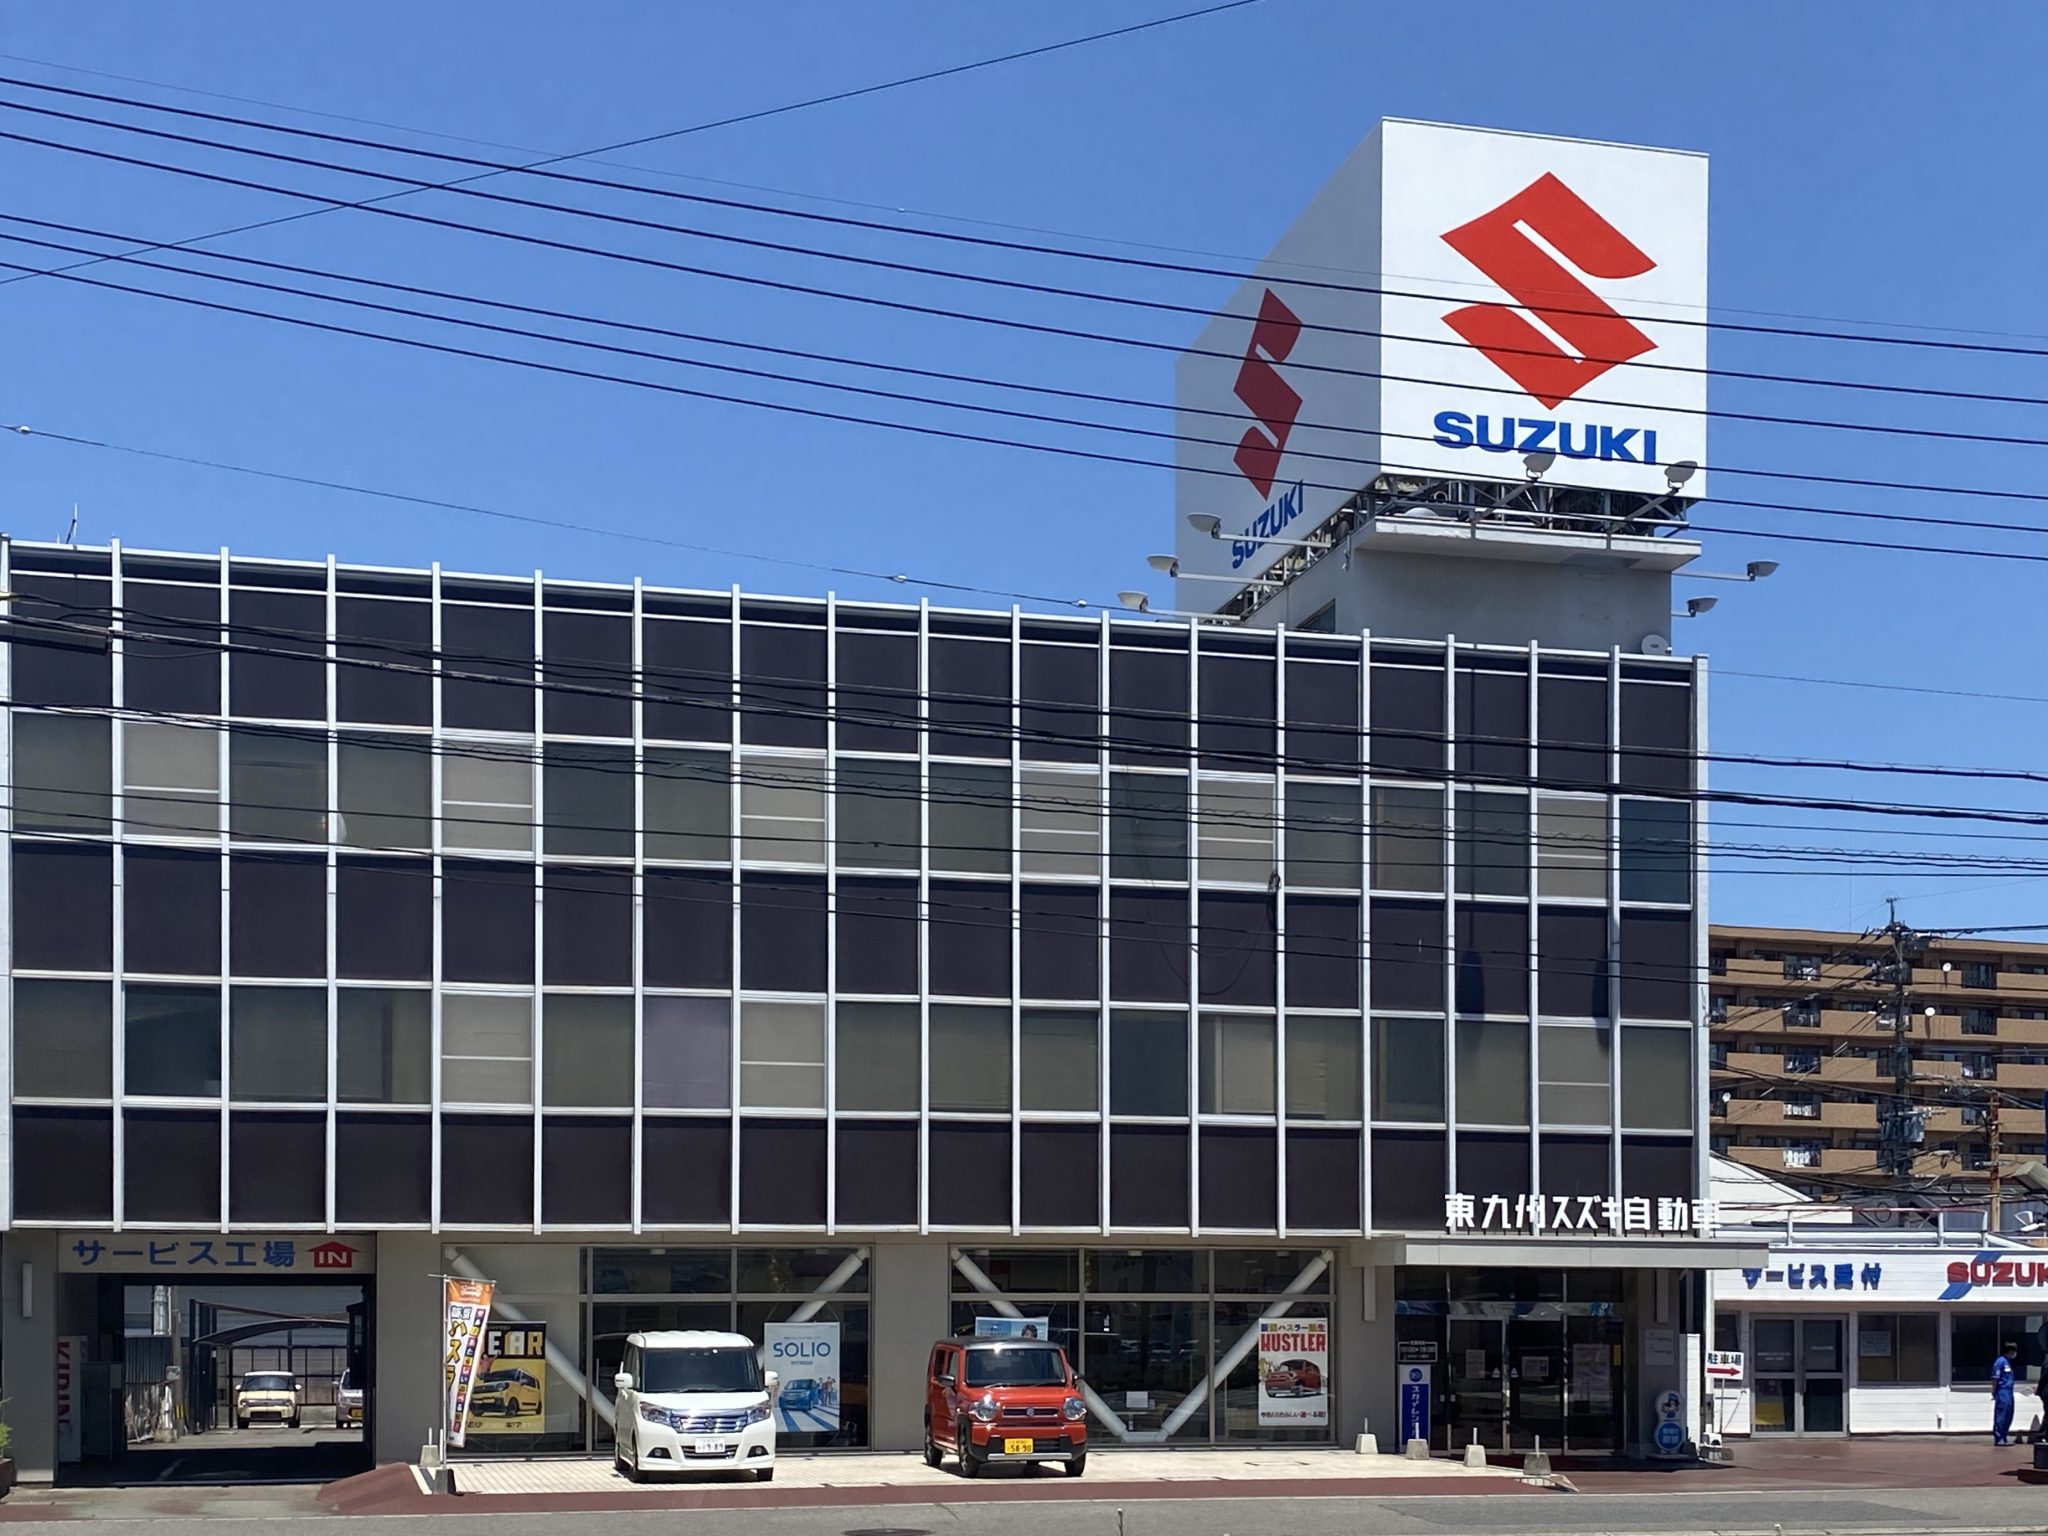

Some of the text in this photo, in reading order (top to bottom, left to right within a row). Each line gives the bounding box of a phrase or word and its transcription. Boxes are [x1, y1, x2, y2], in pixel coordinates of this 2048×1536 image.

[1433, 411, 1656, 465] SUZUKI
[1232, 479, 1303, 569] SUZUKI
[1445, 1192, 1722, 1231] 東九州スズキ自動車
[72, 1240, 295, 1267] サービス工場
[319, 1253, 347, 1264] IN
[773, 1342, 831, 1357] SOLIO
[1261, 1333, 1326, 1352] HUSTLER
[1707, 1353, 1742, 1366] 駐車場
